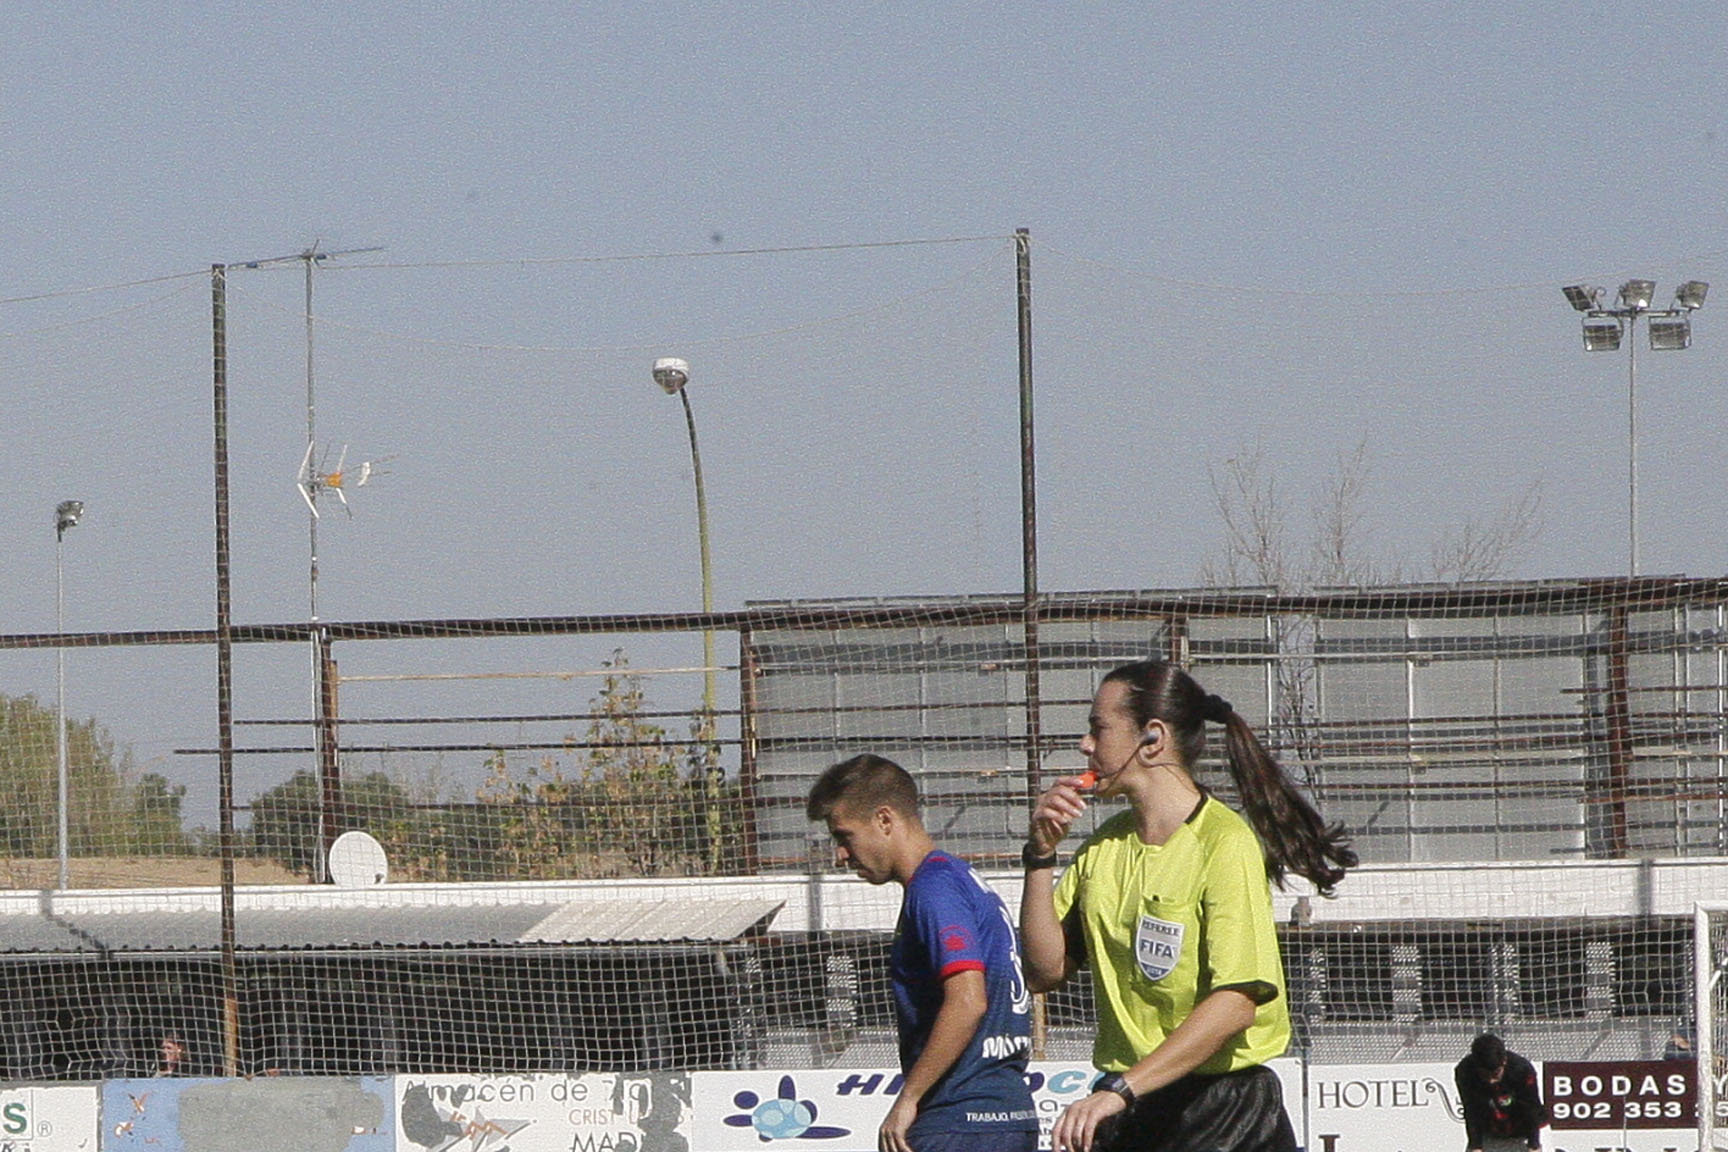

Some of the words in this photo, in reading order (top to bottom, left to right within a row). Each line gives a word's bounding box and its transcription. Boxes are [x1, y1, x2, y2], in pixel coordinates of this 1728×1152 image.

[1140, 939, 1174, 958] FIFA
[402, 1078, 535, 1102] Amacén
[551, 1079, 589, 1102] de
[1318, 1080, 1429, 1109] HOTEL
[1553, 1075, 1686, 1096] BODAS
[1553, 1102, 1611, 1119] 902
[1625, 1101, 1682, 1118] 353
